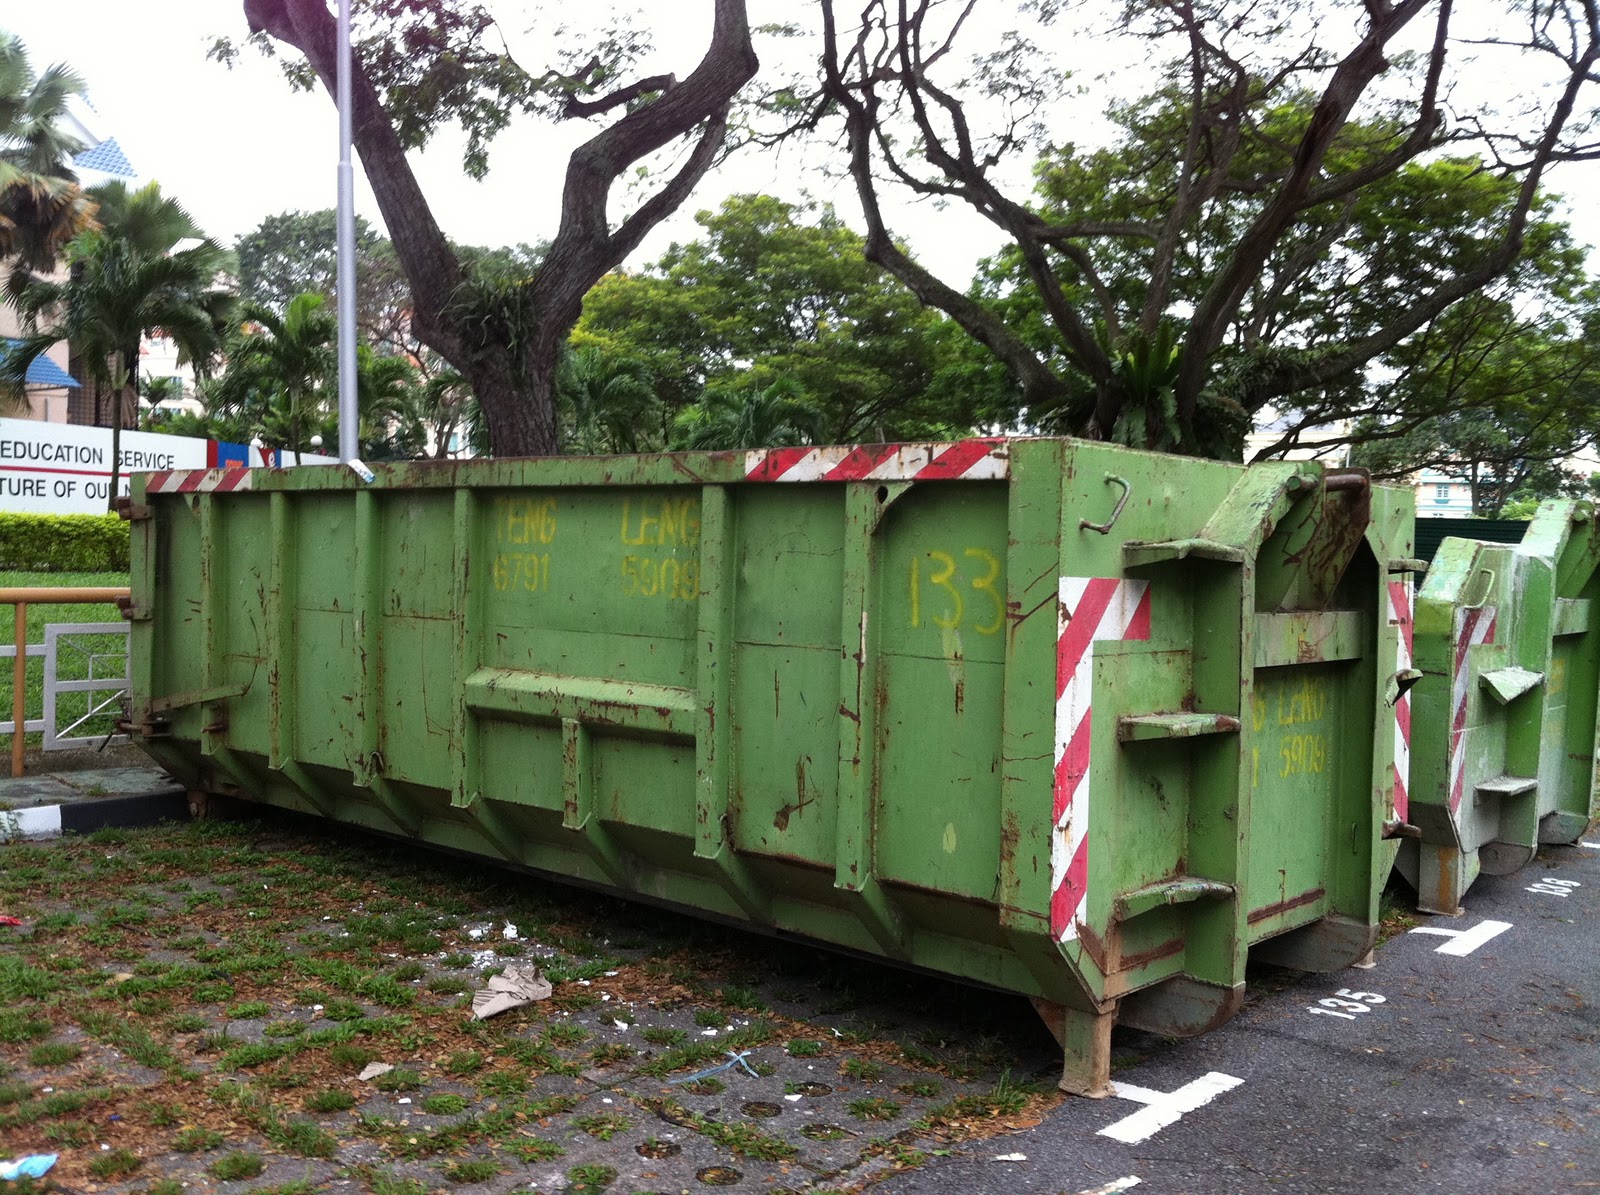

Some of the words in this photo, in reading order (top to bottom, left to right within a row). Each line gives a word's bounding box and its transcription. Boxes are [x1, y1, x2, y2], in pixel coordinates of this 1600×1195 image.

[0, 440, 103, 465] EDUCATION
[118, 449, 175, 471] SERVICE
[53, 480, 77, 498] OF
[84, 482, 113, 499] OU
[910, 548, 1004, 634] 133
[1306, 988, 1386, 1021] 135
